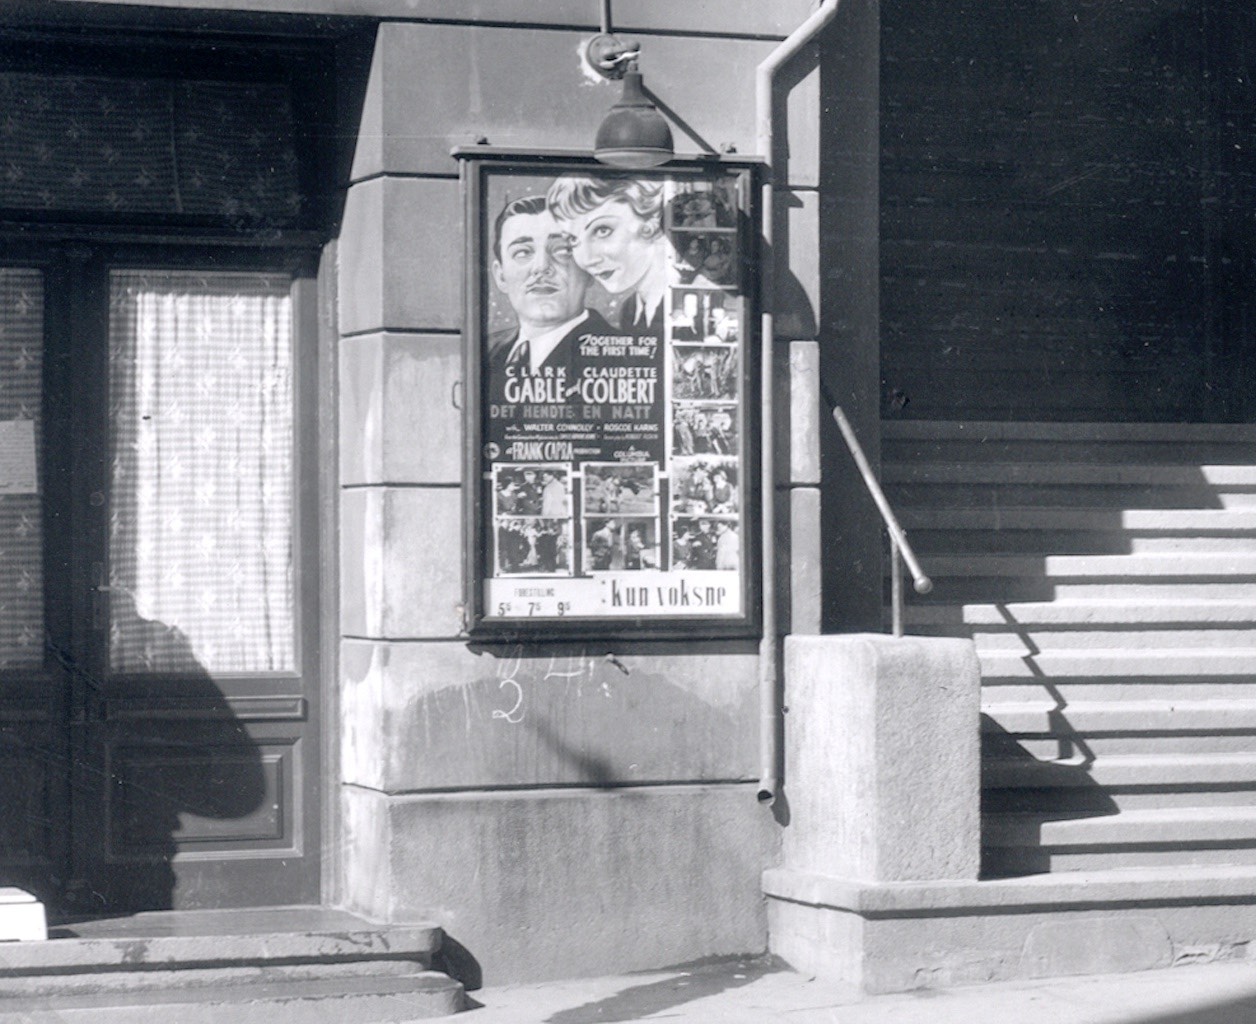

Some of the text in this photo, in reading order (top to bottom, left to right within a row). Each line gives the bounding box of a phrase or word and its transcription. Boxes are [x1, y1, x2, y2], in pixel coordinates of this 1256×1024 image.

[638, 336, 658, 346] FOR
[580, 346, 657, 359] THE FIRST TIME!
[505, 366, 657, 378] CLARK CLAUDETTE
[504, 378, 566, 404] GABLE
[582, 378, 658, 404] COLBERT
[490, 404, 516, 419] DET
[583, 405, 601, 419] EN
[612, 405, 652, 419] NATT
[523, 423, 554, 432] WALTER
[556, 423, 594, 432] CONNOLLY
[603, 423, 632, 432] ROSCOE
[633, 423, 659, 432] KARNS
[512, 441, 544, 461] FRANK
[544, 441, 575, 461] CAPRA
[656, 579, 727, 607] voksne
